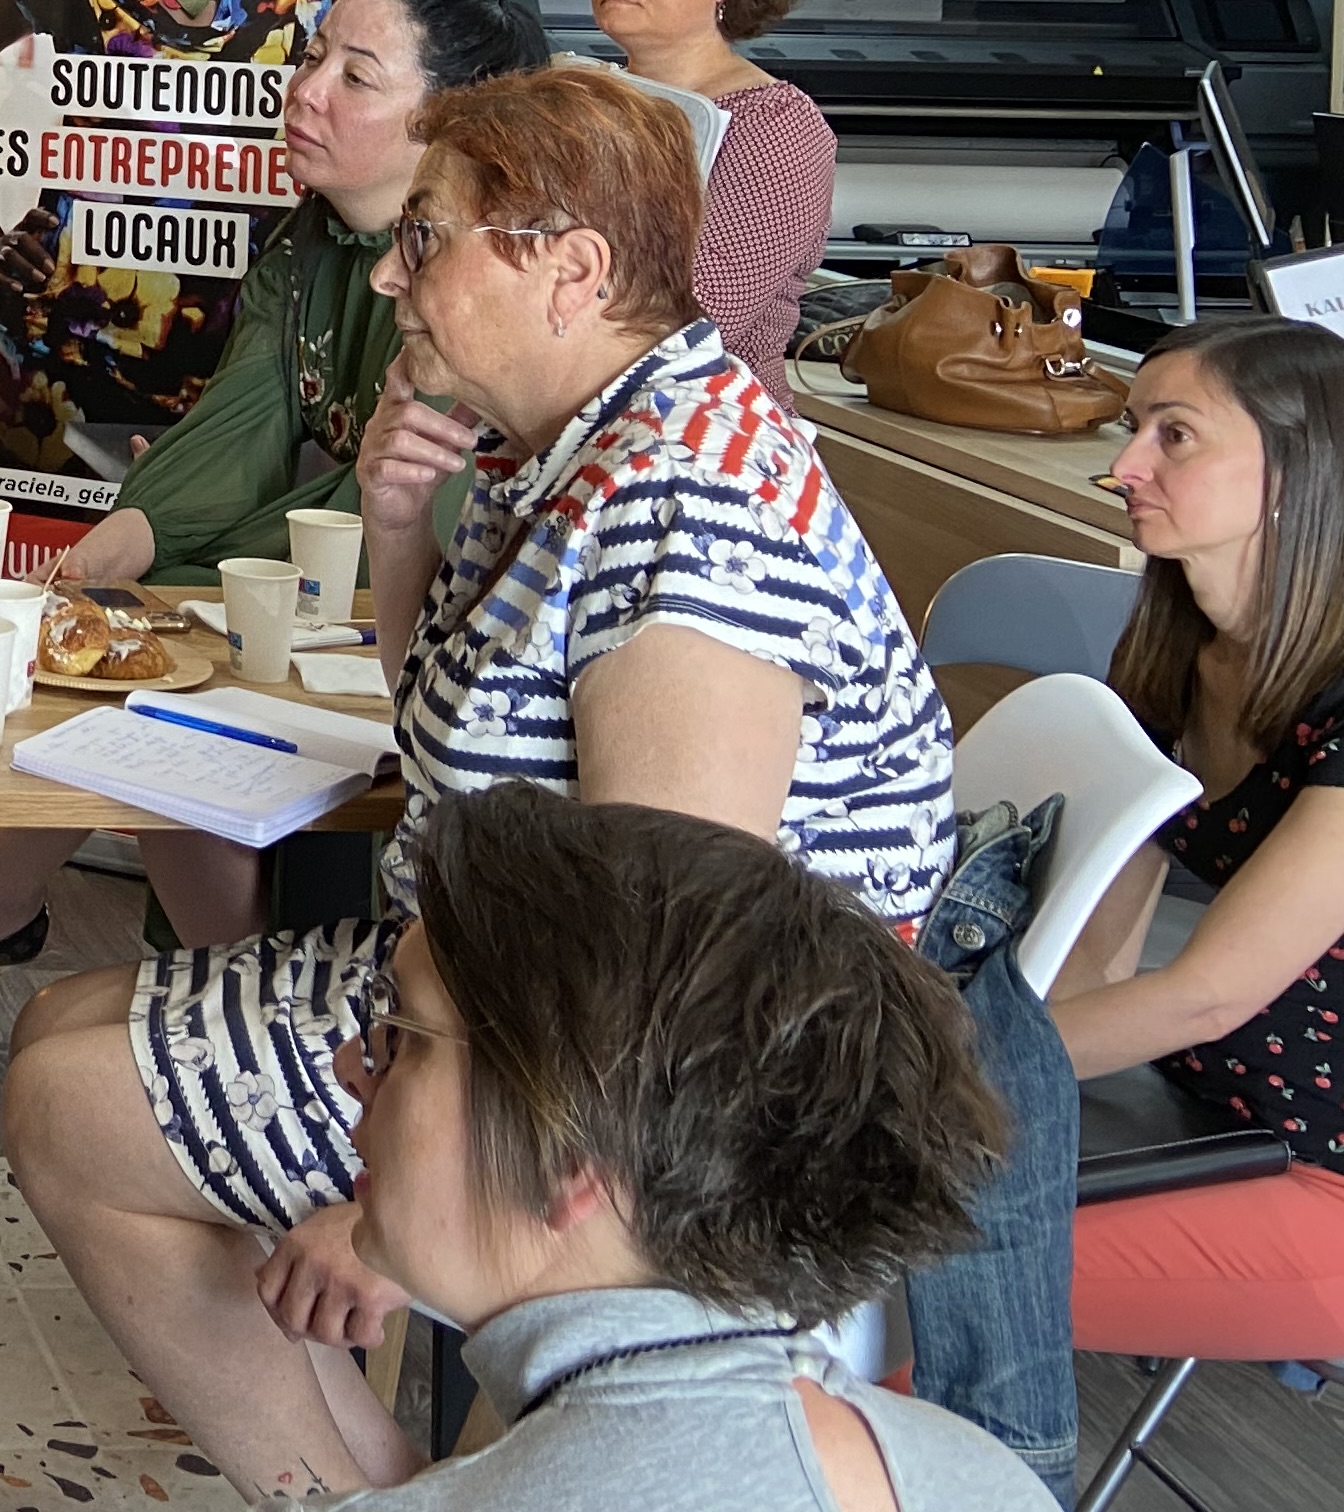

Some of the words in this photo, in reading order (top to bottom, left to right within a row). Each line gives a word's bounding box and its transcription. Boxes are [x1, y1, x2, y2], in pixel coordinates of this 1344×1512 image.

[50, 59, 283, 119] SOUTENONS
[40, 132, 306, 199] ENTREPRENE
[85, 208, 237, 269] LOCAUX
